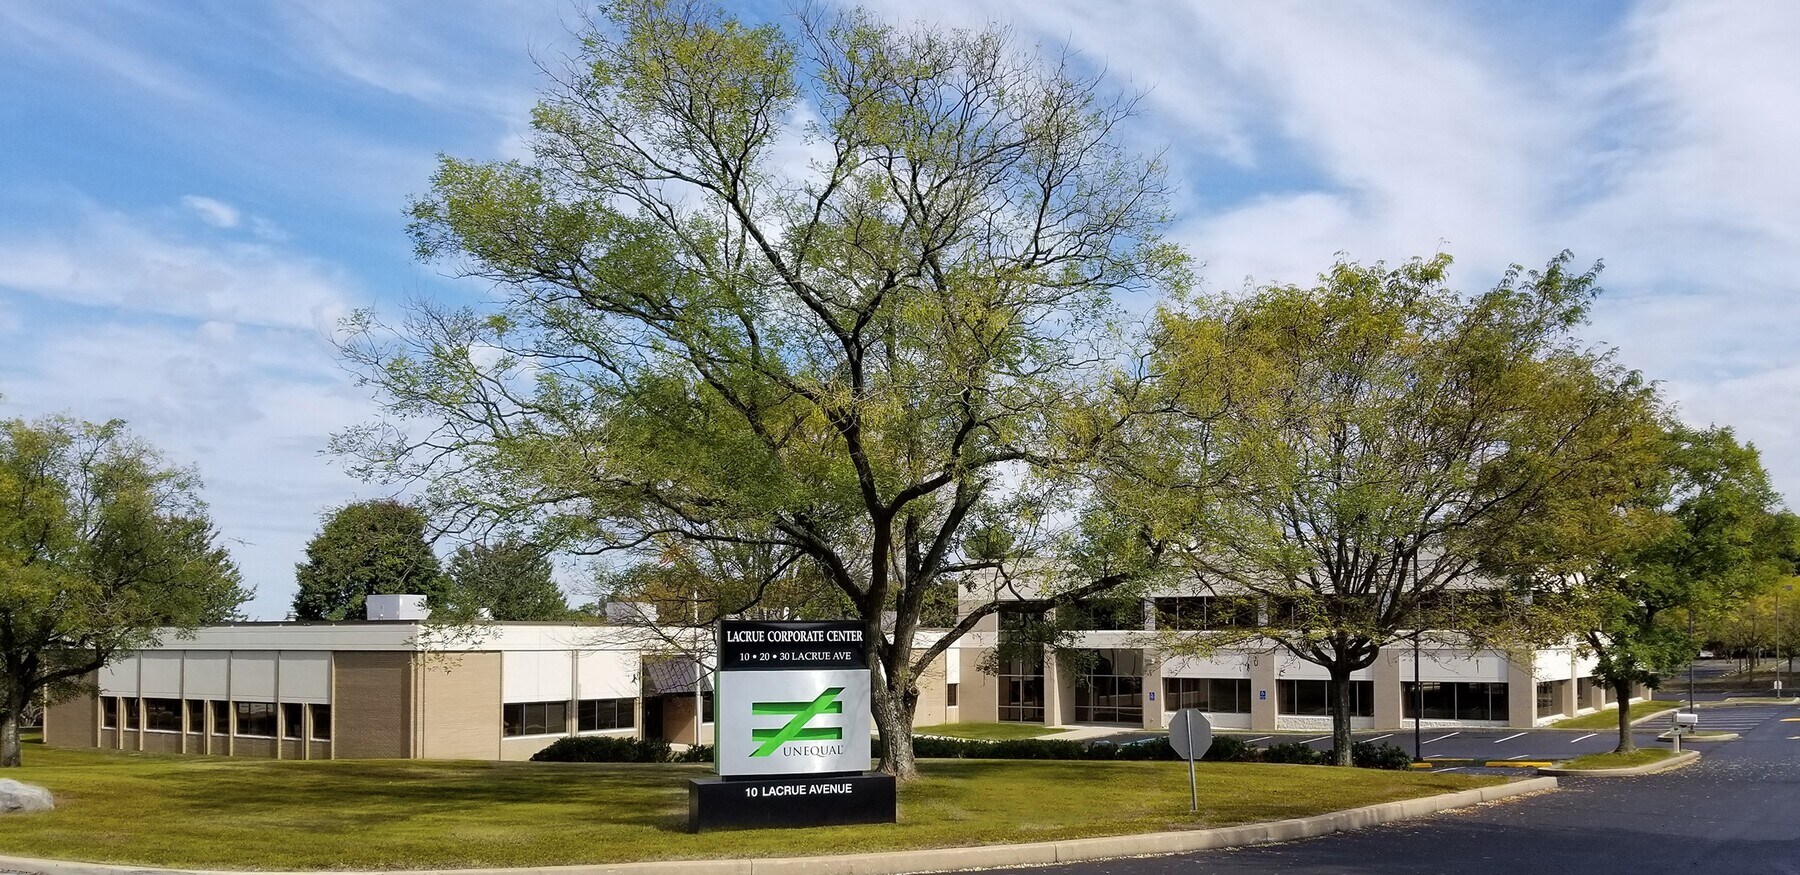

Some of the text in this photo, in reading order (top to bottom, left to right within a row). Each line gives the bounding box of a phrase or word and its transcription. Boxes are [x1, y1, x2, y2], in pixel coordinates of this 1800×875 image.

[727, 630, 863, 643] LACRUE CORPORATE CENTER
[740, 652, 851, 661] 10 20 30 LACRUE AVE
[784, 745, 843, 757] UNEQUAL
[746, 784, 852, 797] 10 LACRUE AVENUE
